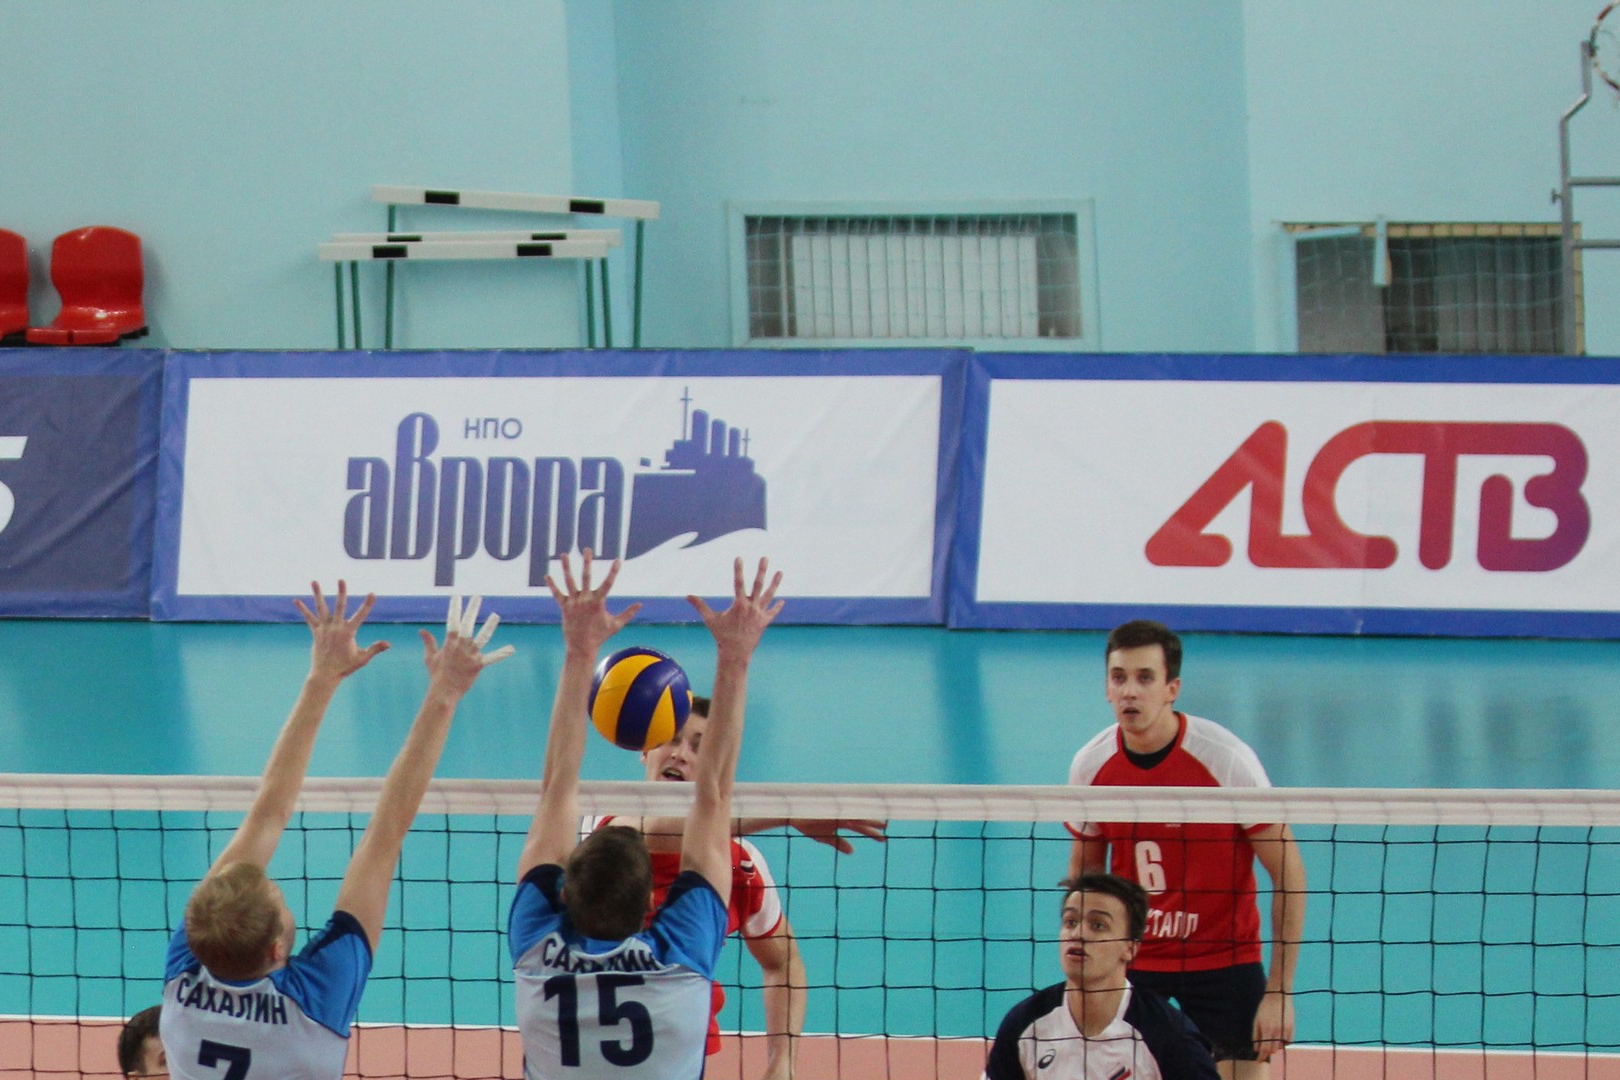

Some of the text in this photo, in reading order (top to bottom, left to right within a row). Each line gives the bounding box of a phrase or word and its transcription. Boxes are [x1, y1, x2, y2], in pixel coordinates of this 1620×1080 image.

[464, 417, 522, 439] НПО
[1135, 841, 1166, 895] 6
[176, 977, 288, 1025] САХАЛИН
[544, 974, 654, 1067] 15
